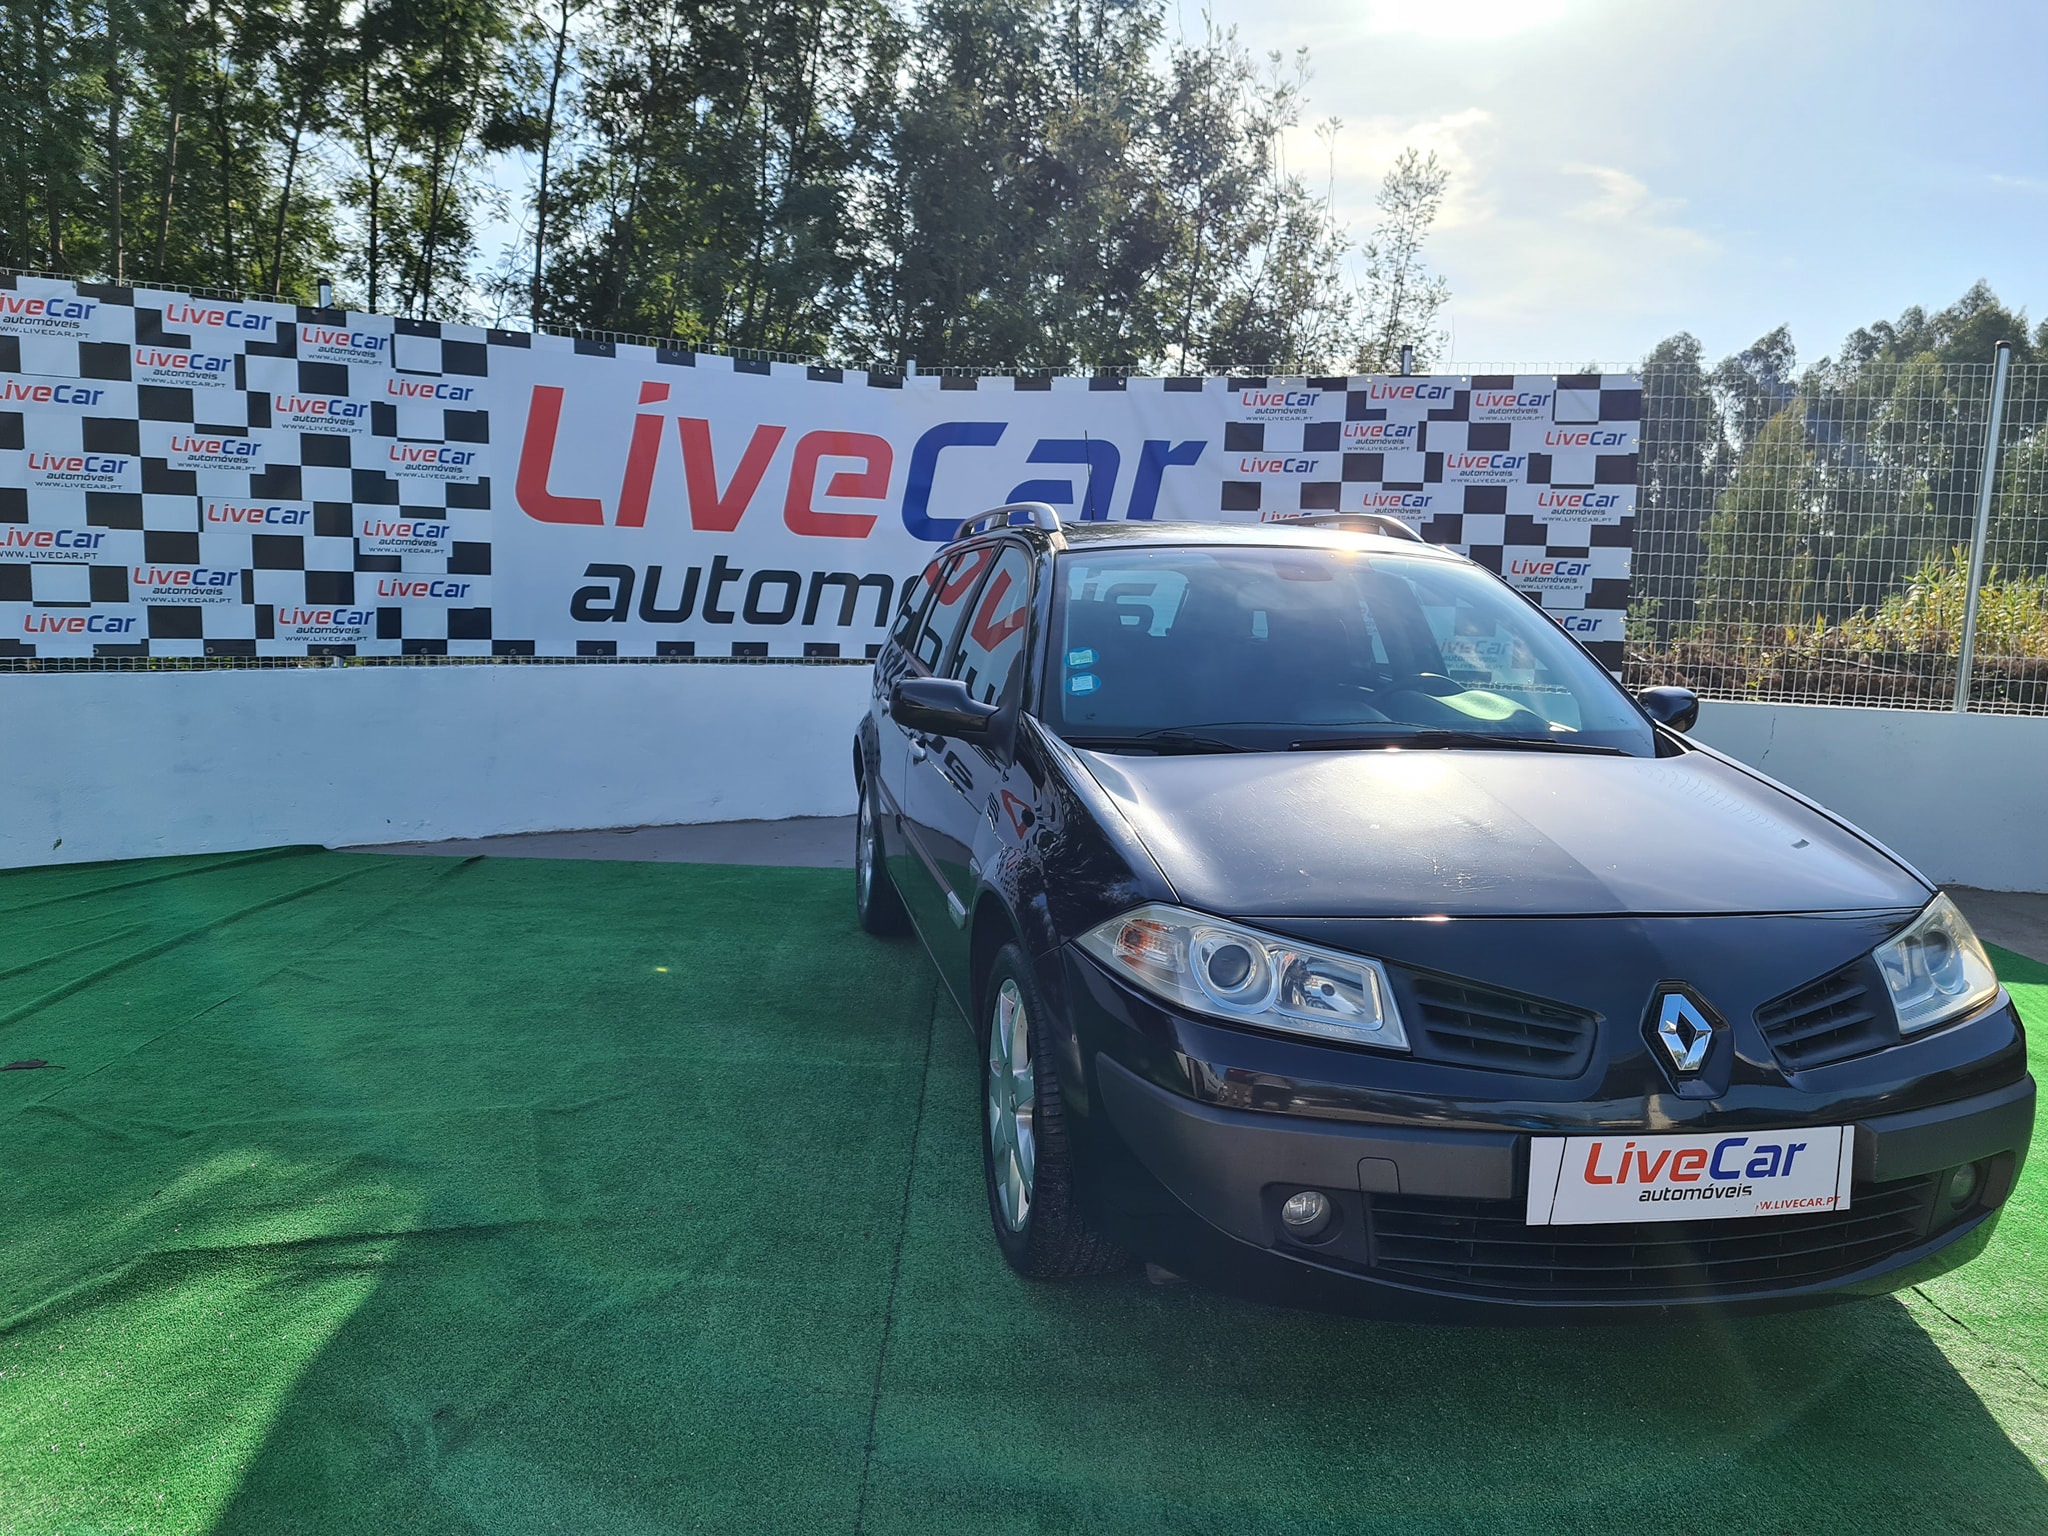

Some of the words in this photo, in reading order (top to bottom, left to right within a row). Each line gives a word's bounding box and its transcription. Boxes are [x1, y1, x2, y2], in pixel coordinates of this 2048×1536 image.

[0, 292, 96, 319] iveCar
[3, 316, 80, 329] automóveis
[166, 304, 272, 331] LiveCar
[0, 326, 90, 338] WW.LIVECAR.PT
[302, 327, 388, 350] LiveCar
[318, 345, 376, 358] automóveis
[135, 349, 232, 372] LiveCar
[153, 369, 218, 380] automóveis
[0, 380, 104, 405] iveCar
[387, 379, 474, 401] LiveCar
[1370, 383, 1451, 400] LiveCar
[275, 395, 368, 418] LiveCar
[1242, 391, 1320, 407] LiveCar
[1475, 392, 1551, 407] LiveCar
[1254, 407, 1307, 415] automóveis
[1487, 407, 1539, 415] automóveis
[292, 415, 355, 426] automóveis
[1343, 422, 1416, 438] LiveCar
[1545, 430, 1627, 446] LiveCar
[170, 436, 261, 457] LiveCar
[1355, 437, 1405, 445] automóveis
[28, 453, 128, 474] LiveCar
[187, 454, 249, 464] automóveis
[389, 445, 475, 465] LiveCar
[515, 380, 1208, 542] LiveCar
[1446, 453, 1526, 469] LiveCar
[405, 463, 463, 474] automóveis
[1240, 457, 1319, 473] LiveCar
[1459, 469, 1513, 477] automóveis
[46, 472, 114, 482] automóveis
[1363, 492, 1433, 508] LiveCar
[1537, 491, 1620, 508] LiveCar
[207, 504, 310, 524] LiveCar
[1550, 508, 1606, 516] automóveis
[0, 527, 106, 548] iveCar
[363, 520, 449, 538] LiveCar
[378, 538, 438, 547] automóveis
[132, 566, 238, 586] LiveCar
[1511, 559, 1591, 576] LiveCar
[377, 578, 470, 598] LiveCar
[1523, 575, 1578, 584] automóveis
[152, 586, 223, 596] automóveis
[570, 555, 918, 627] autom
[24, 613, 136, 634] LiveCar
[278, 607, 374, 625] LiveCar
[296, 625, 360, 635] automóveis
[1584, 1137, 1807, 1185] LiveCar
[1639, 1182, 1752, 1202] automóveis
[1754, 1196, 1840, 1216] W.LIVECAR.PT
